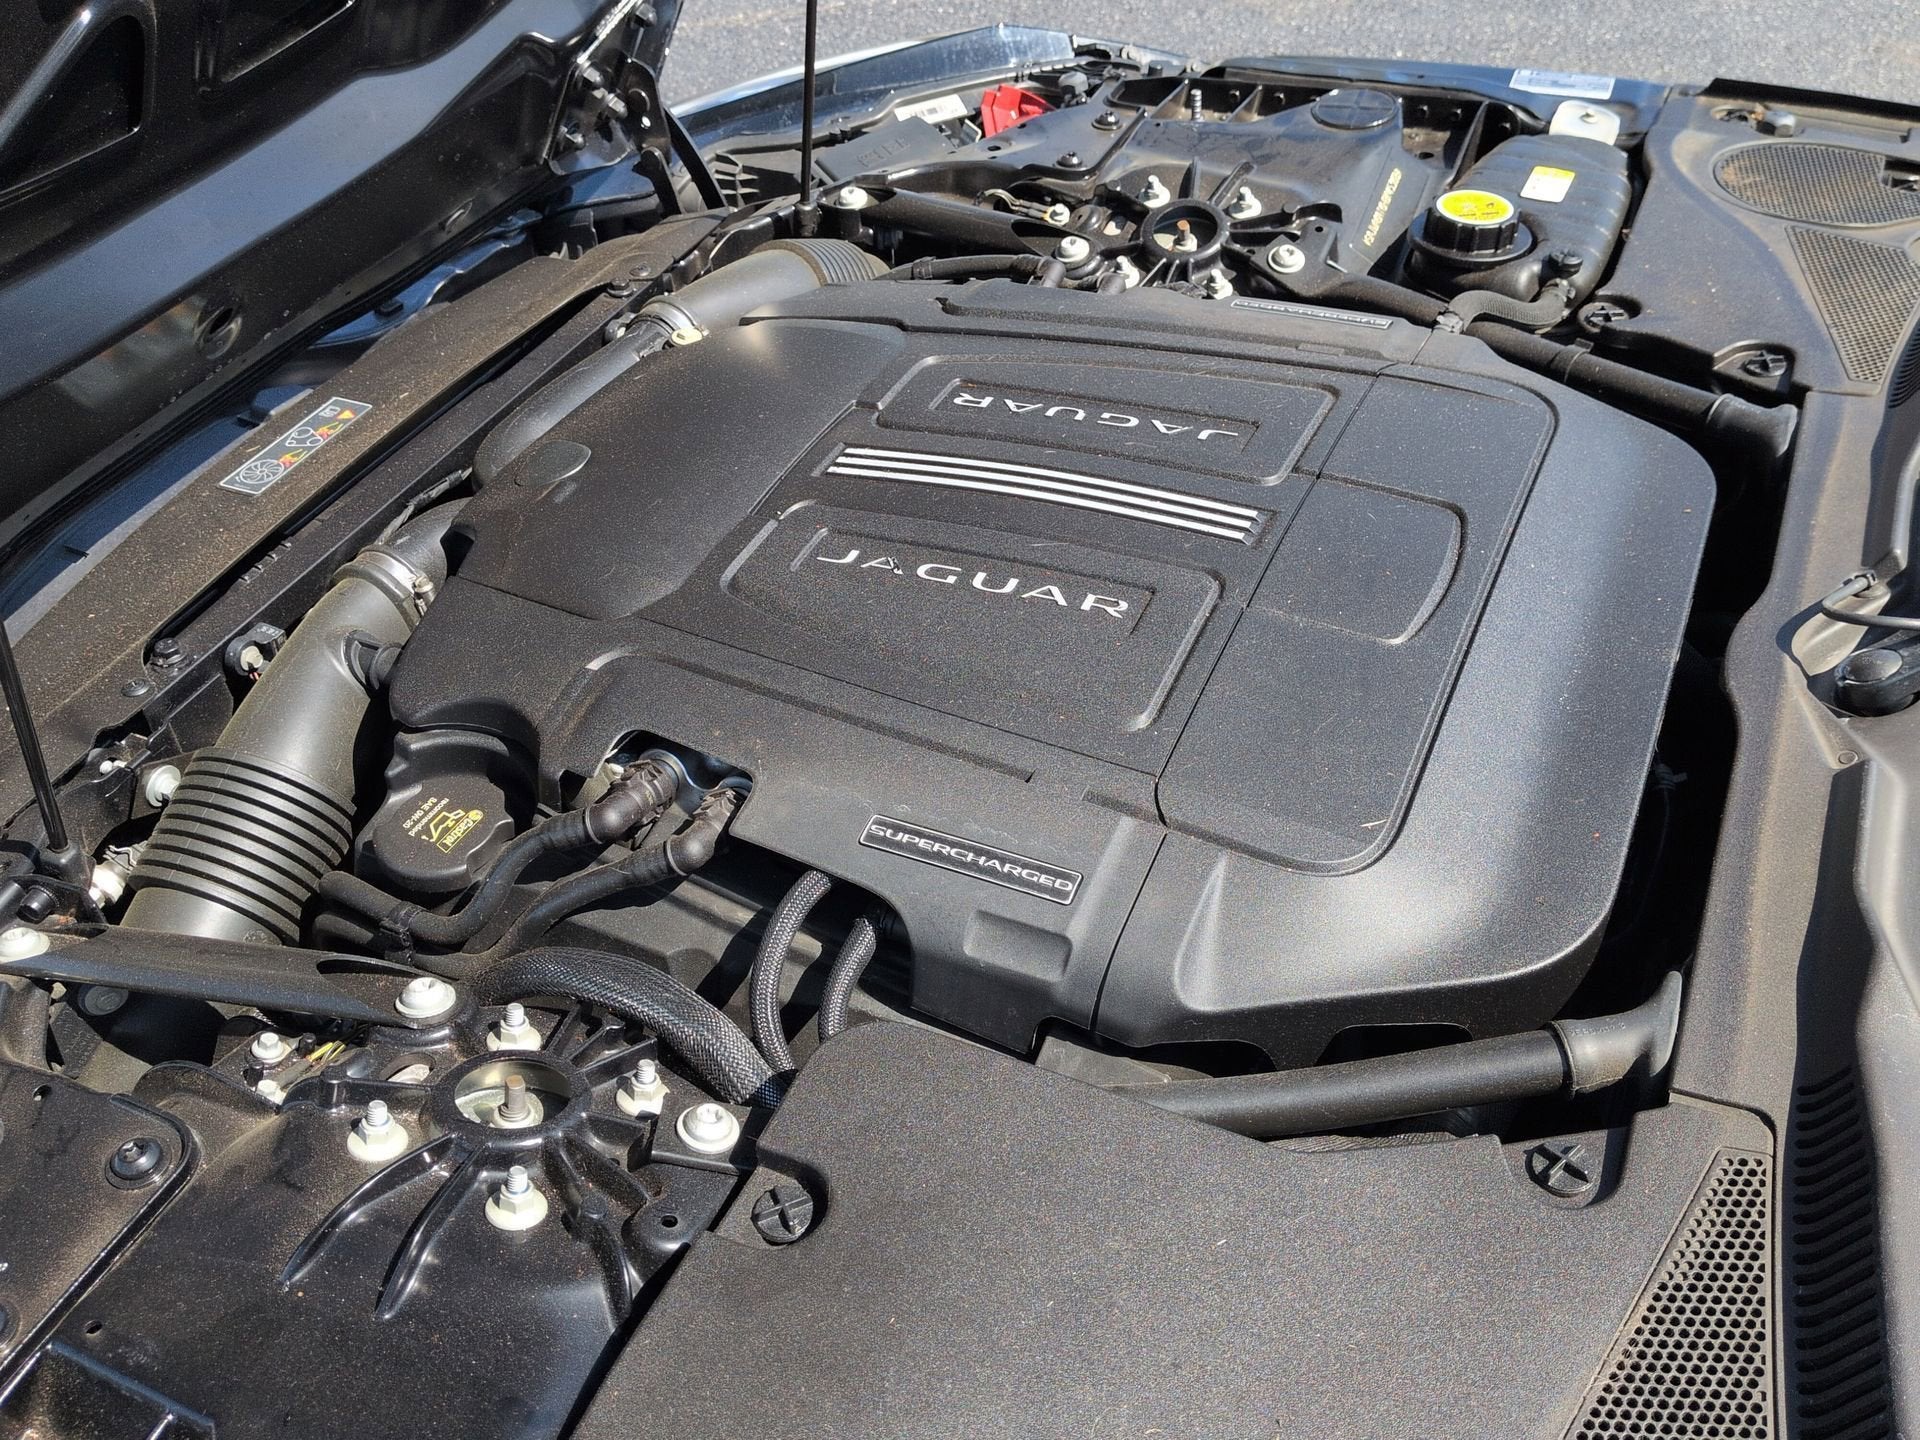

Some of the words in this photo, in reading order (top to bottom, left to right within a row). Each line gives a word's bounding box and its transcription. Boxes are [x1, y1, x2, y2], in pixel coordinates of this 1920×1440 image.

[953, 393, 1239, 441] JAGUAR
[816, 549, 1129, 618] JAGUAR
[408, 797, 449, 836] recommended
[421, 797, 437, 811] SAE
[442, 817, 474, 847] Castrol
[869, 824, 1073, 892] SUPERCHARGED
